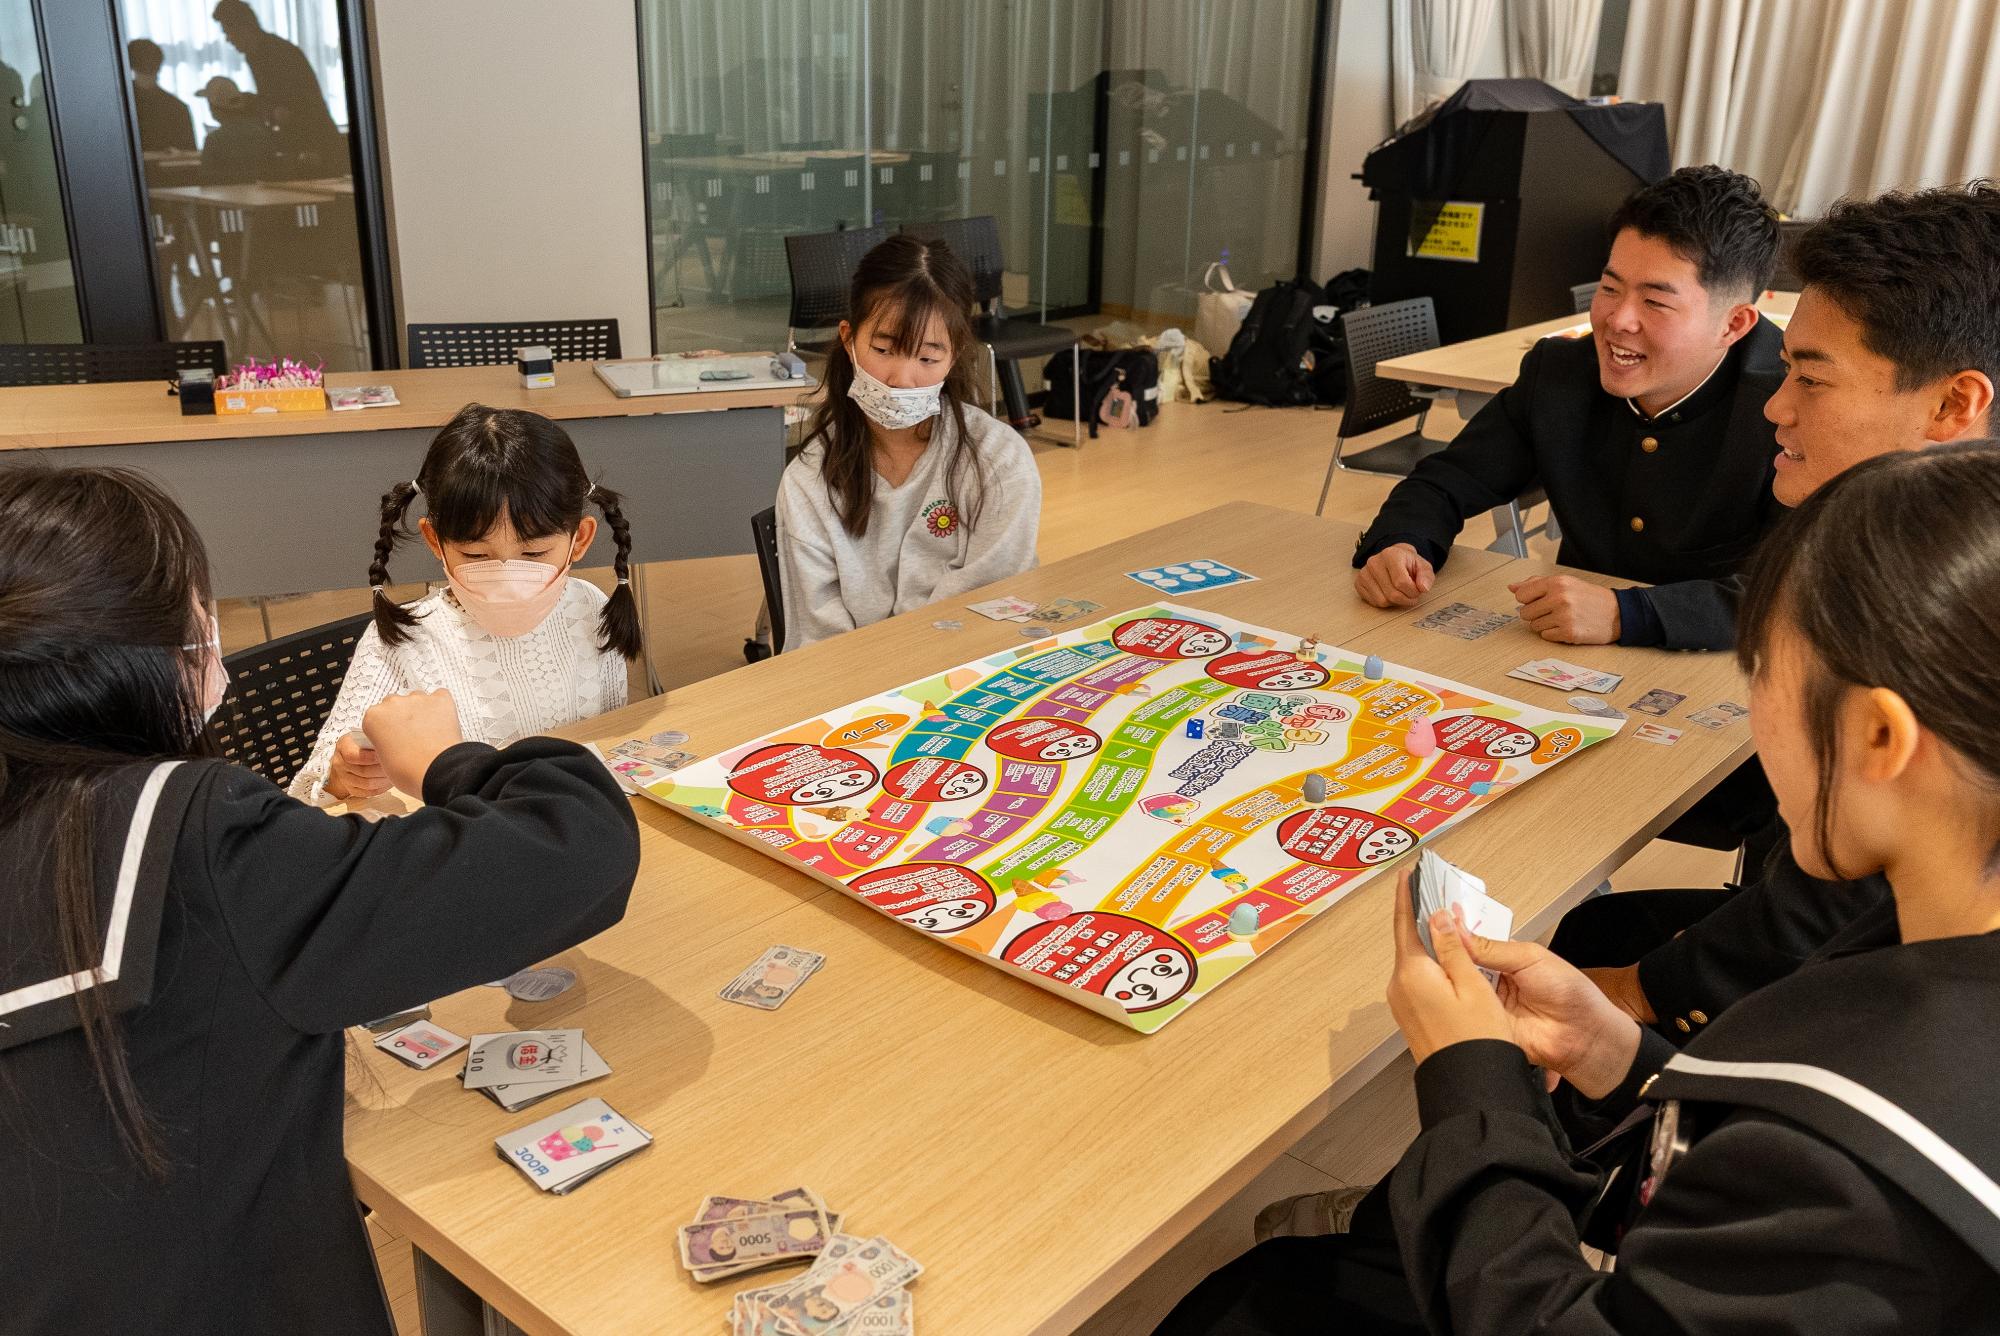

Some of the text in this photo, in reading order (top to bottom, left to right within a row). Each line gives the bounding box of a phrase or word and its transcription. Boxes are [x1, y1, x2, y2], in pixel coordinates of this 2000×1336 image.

[842, 718, 893, 742] ゴール
[1250, 705, 1345, 750] すごろく
[1543, 731, 1574, 760] スタート
[1176, 746, 1256, 797] アイスクリーム屋さんに
[1295, 873, 1341, 900] アイスクリームを入れる
[472, 1049, 486, 1073] 100
[519, 1043, 540, 1066] 借金
[514, 1145, 551, 1177] 300円
[739, 1232, 772, 1247] 5000
[869, 1260, 896, 1279] 1000
[863, 1315, 894, 1327] 1000
